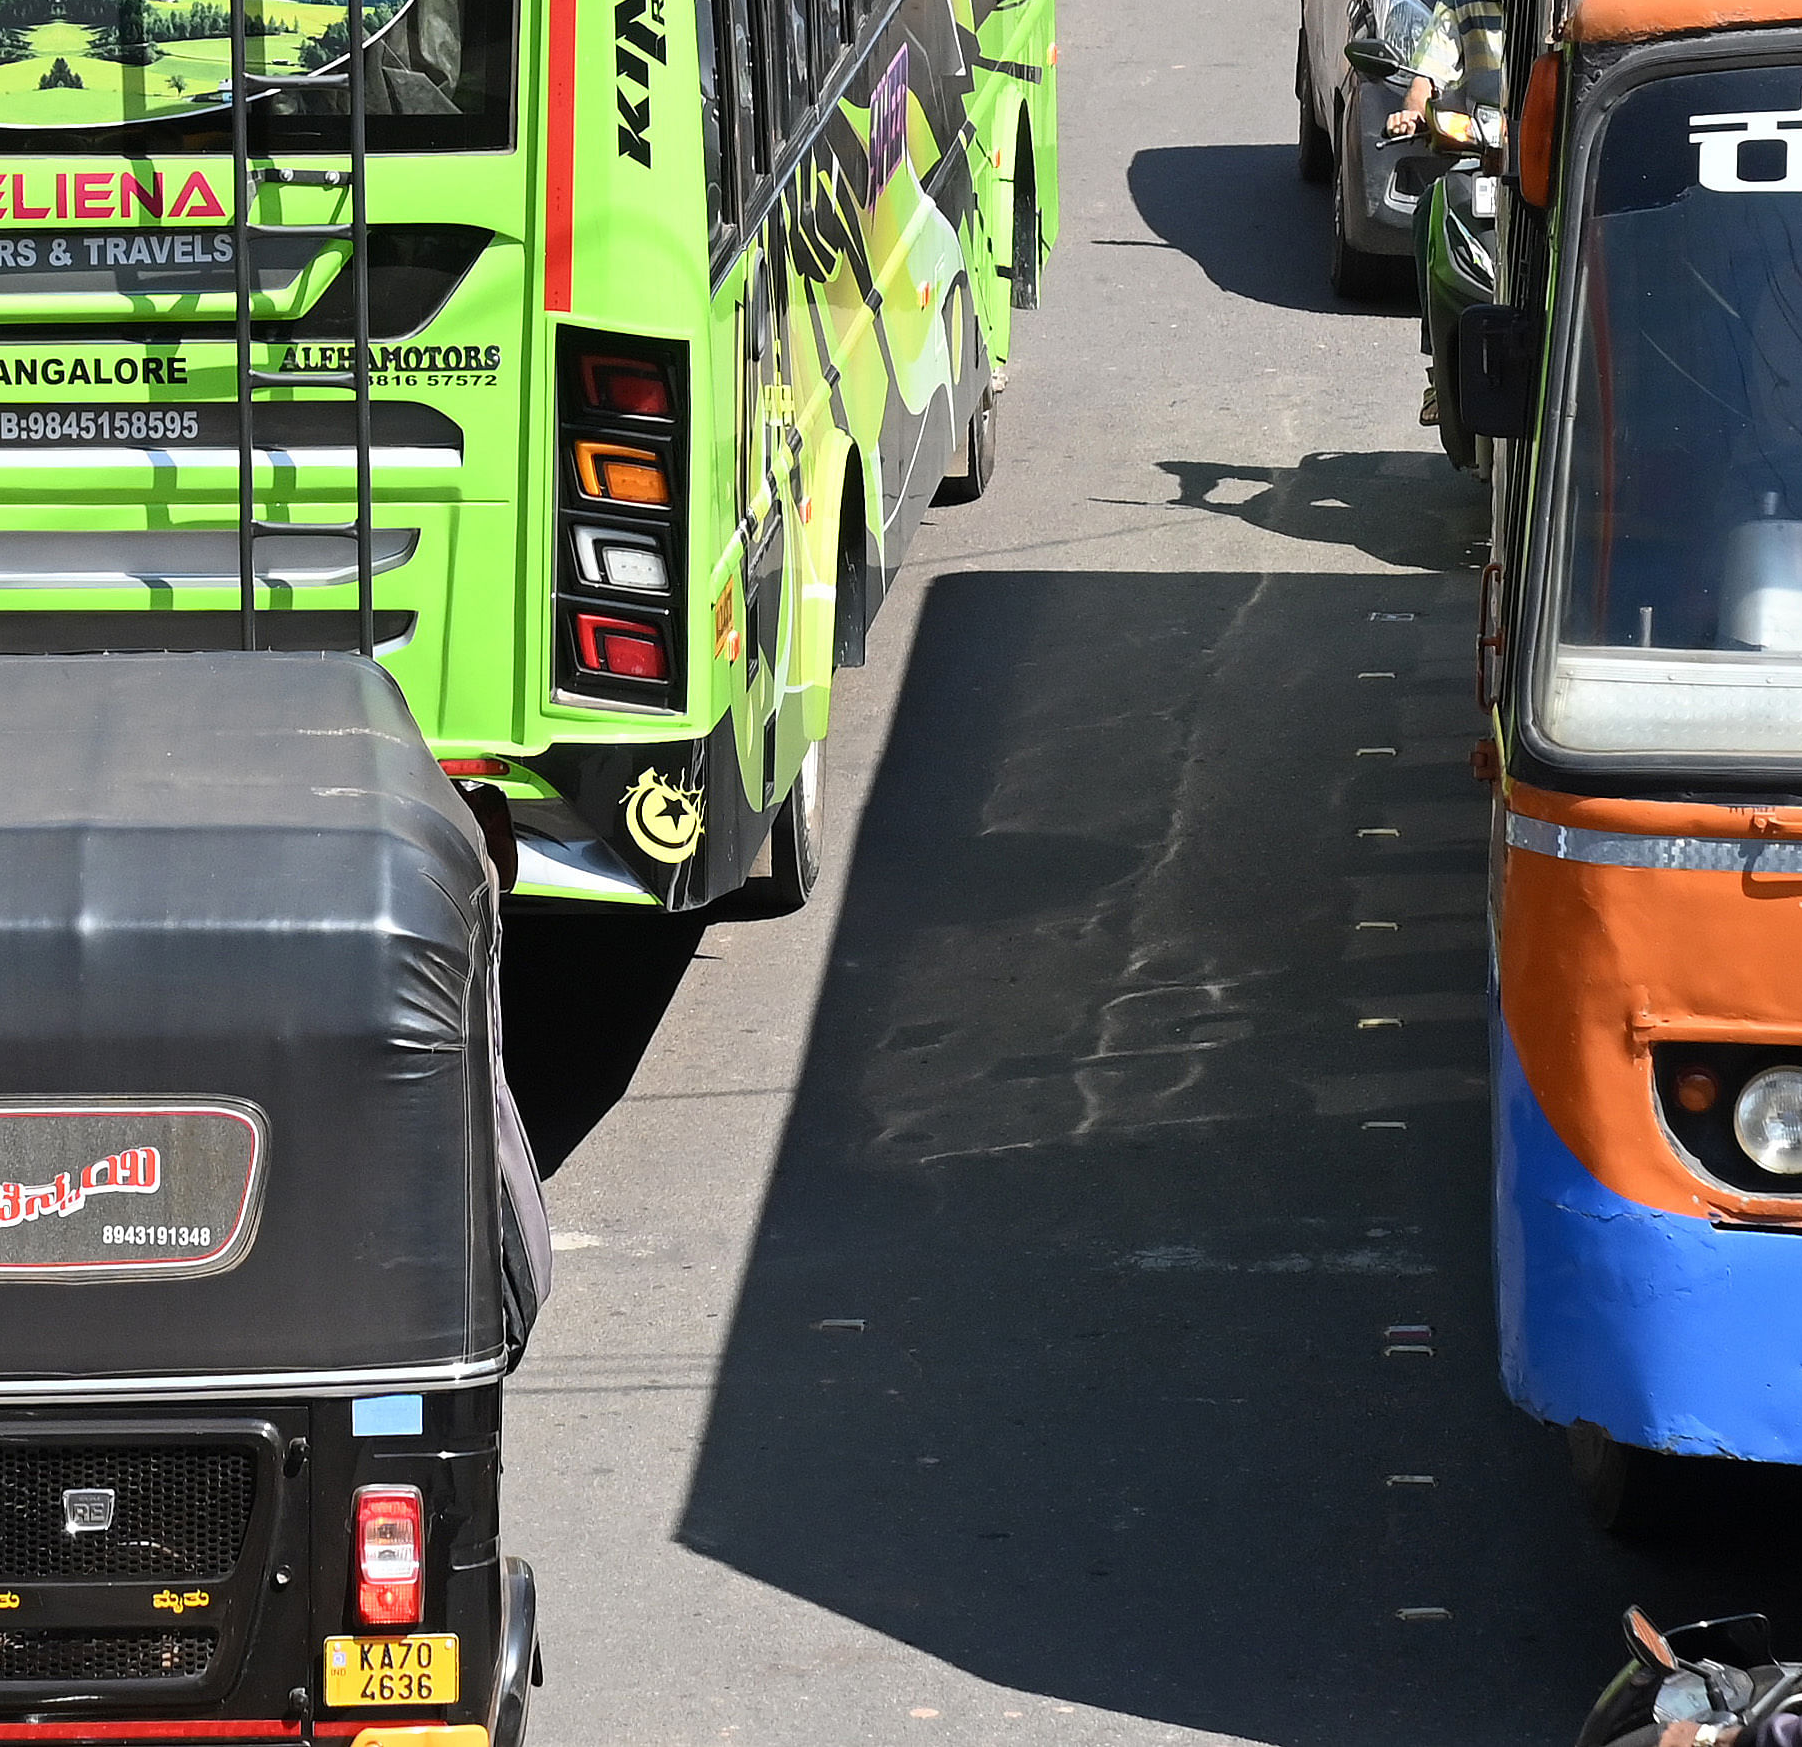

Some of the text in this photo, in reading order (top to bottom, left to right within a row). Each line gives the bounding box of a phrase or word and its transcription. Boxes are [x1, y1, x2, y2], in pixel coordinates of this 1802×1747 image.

[48, 237, 73, 268] &
[83, 232, 235, 266] TRAVELS
[426, 374, 498, 387] 57572
[102, 1224, 212, 1248] 8943191348
[72, 1502, 106, 1523] RE
[359, 1641, 435, 1672] KA70
[359, 1673, 435, 1702] 4636
